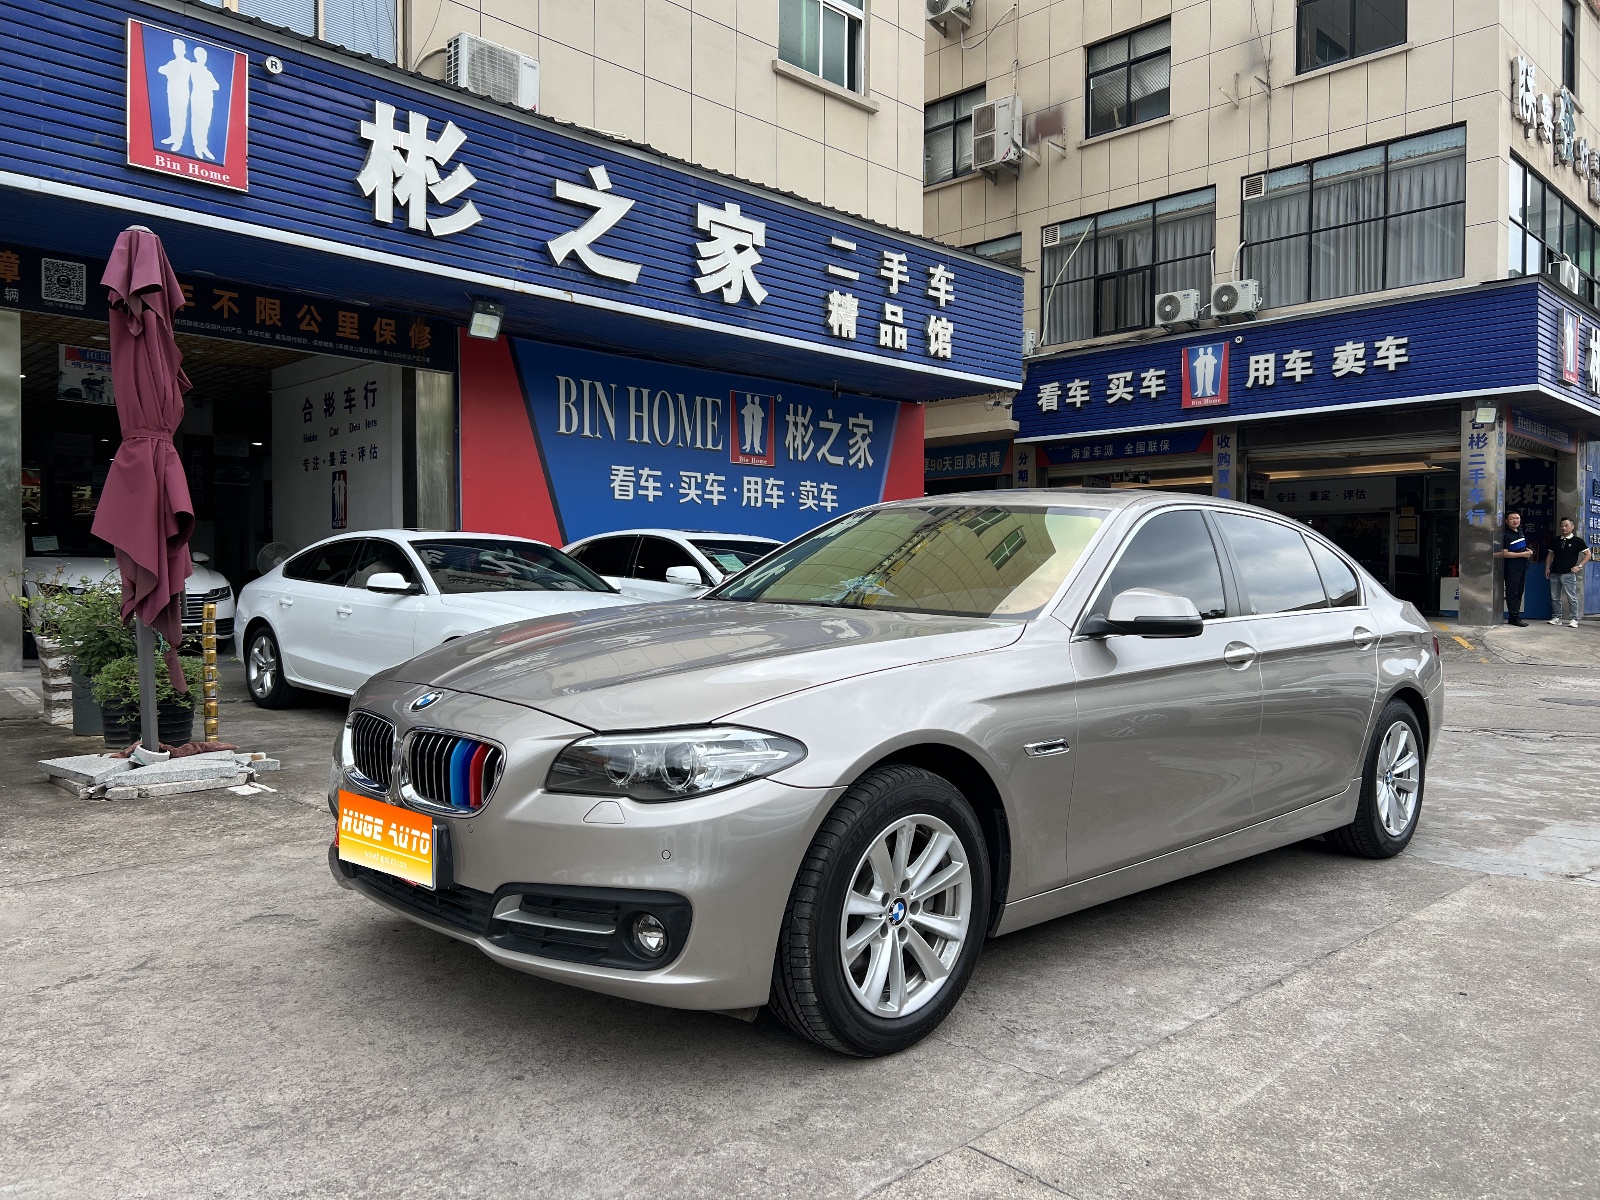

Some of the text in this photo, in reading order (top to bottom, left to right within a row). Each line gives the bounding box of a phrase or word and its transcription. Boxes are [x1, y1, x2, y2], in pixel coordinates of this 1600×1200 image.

[154, 154, 231, 184] Bin Home
[356, 100, 769, 306] 彬之家
[825, 235, 955, 308] 二手车
[826, 289, 955, 359] 精品馆
[1037, 335, 1410, 412] 看车 买车 用车 卖车
[555, 375, 724, 452] BIN HOME
[784, 403, 875, 470] 彬之家
[1123, 439, 1171, 456] 全国联保
[738, 455, 768, 466] Bin Home
[1018, 452, 1029, 488] 分期
